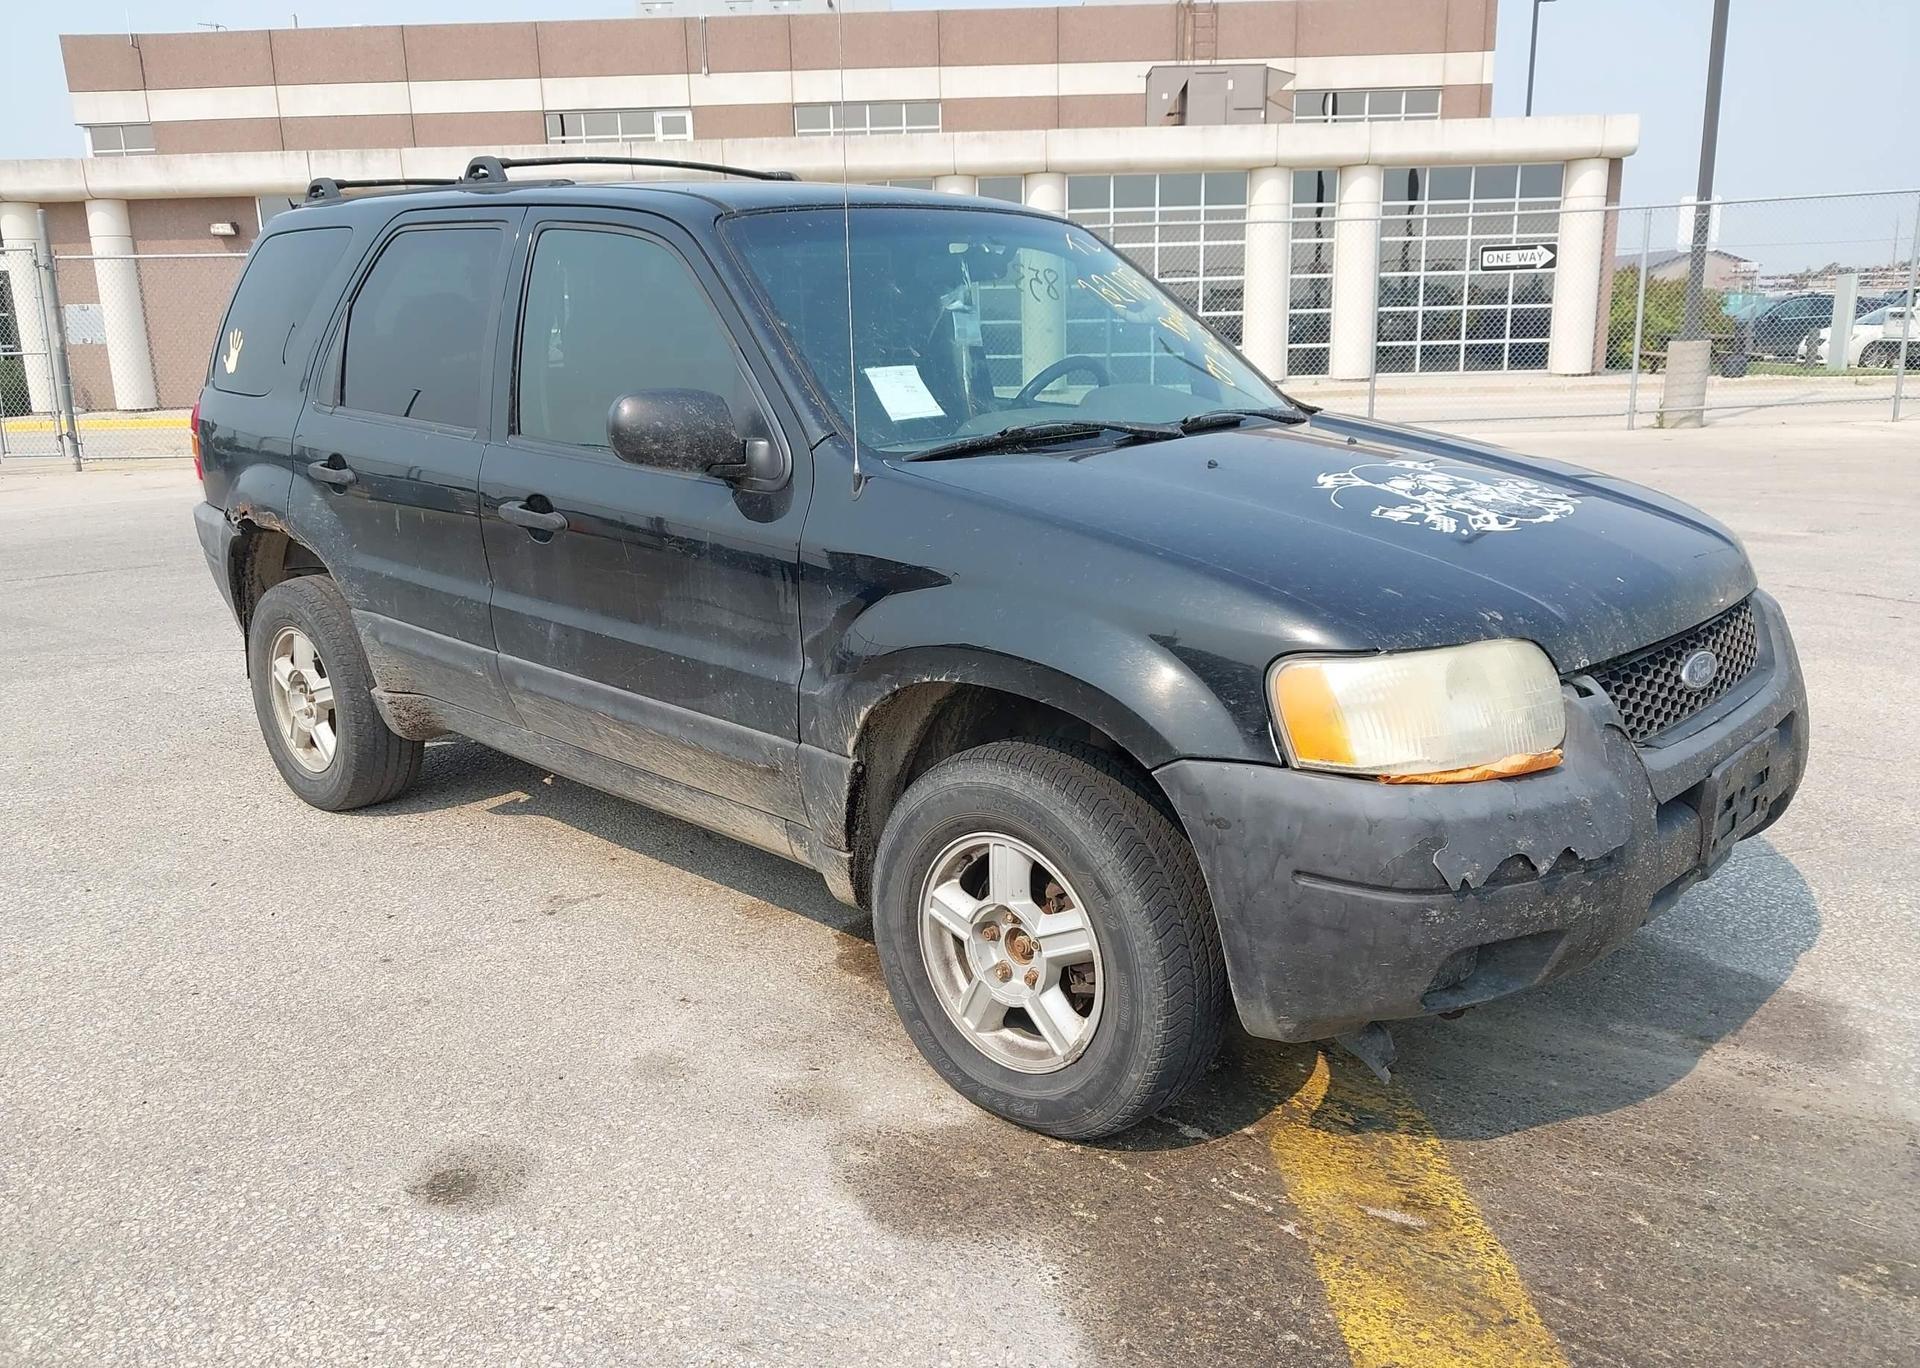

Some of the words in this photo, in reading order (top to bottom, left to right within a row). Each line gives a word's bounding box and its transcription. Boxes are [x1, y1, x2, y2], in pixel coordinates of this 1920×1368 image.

[1486, 252, 1512, 264] ONE
[1517, 251, 1545, 263] WAY
[1693, 657, 1712, 681] Ford
